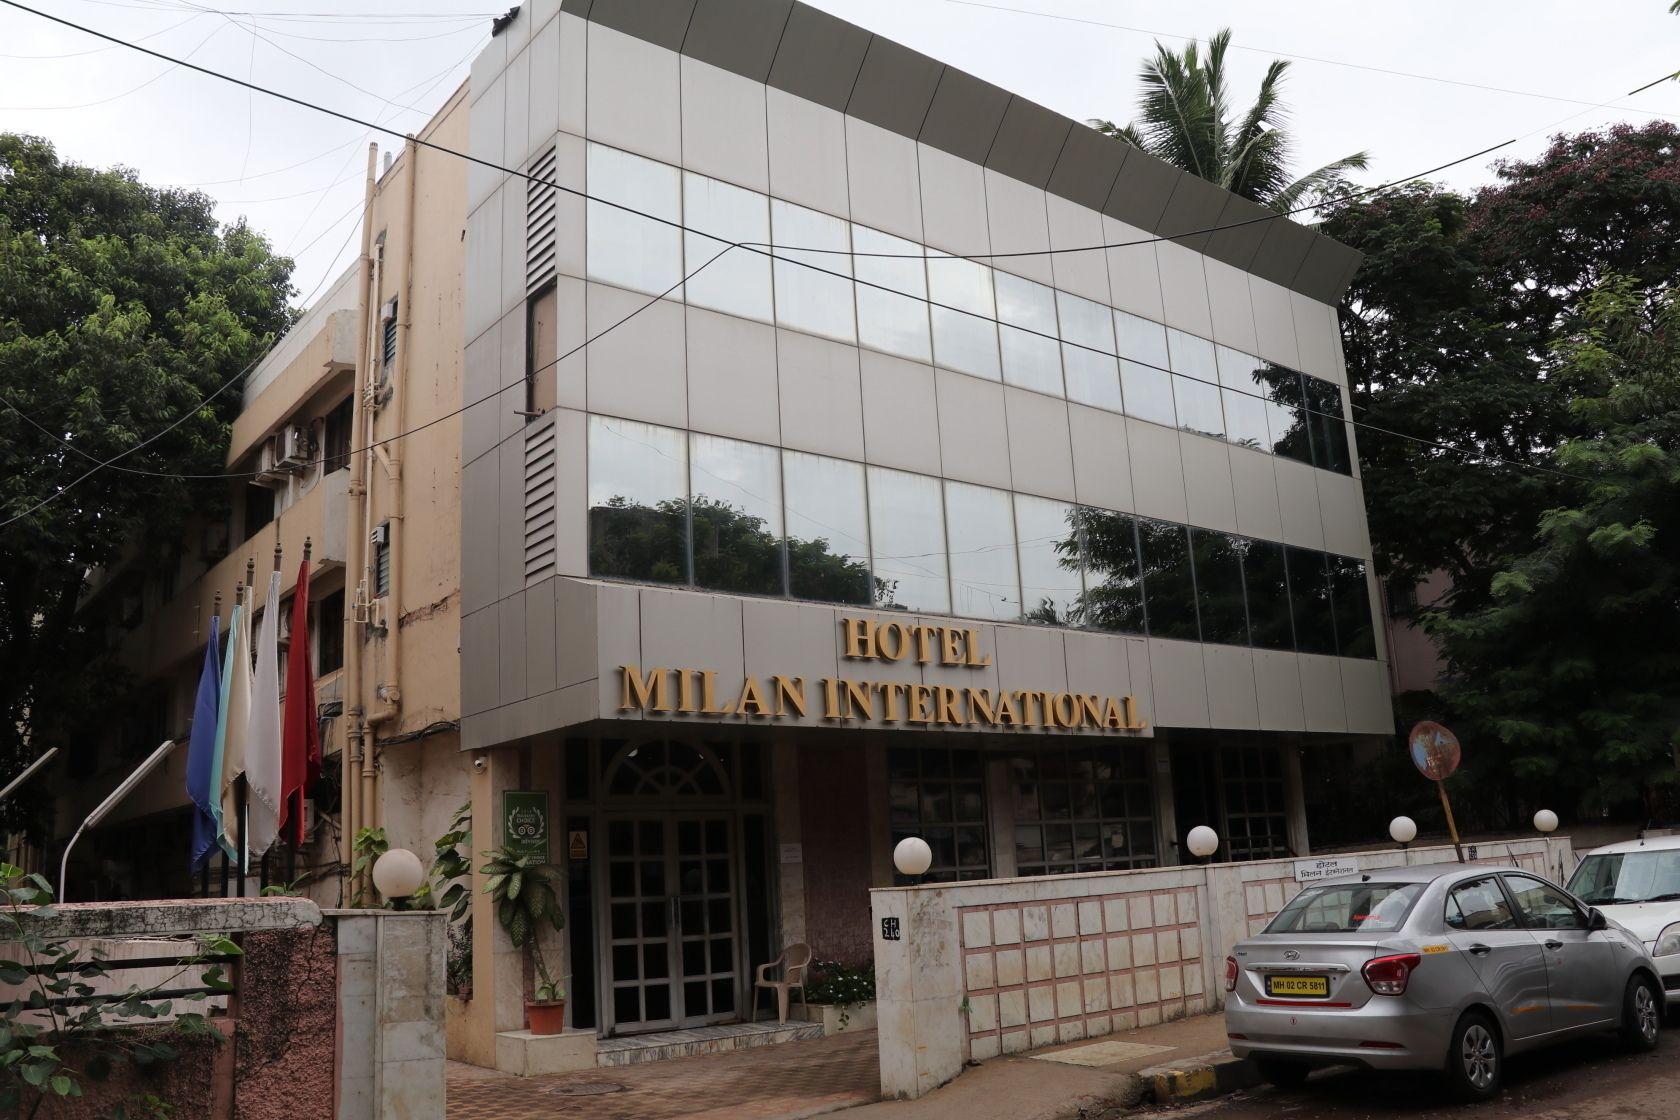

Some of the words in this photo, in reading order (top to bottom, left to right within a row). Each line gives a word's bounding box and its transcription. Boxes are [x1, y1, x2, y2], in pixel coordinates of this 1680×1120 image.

[842, 617, 991, 667] HOTEL
[618, 664, 807, 718] MILAN
[819, 677, 1147, 730] INTERNATIONAL
[1316, 860, 1338, 869] होटल
[1301, 870, 1322, 878] मिलन
[1273, 981, 1285, 989] MH
[1286, 981, 1295, 990] 02
[1296, 981, 1308, 990] CR
[1309, 981, 1325, 990] 5811
